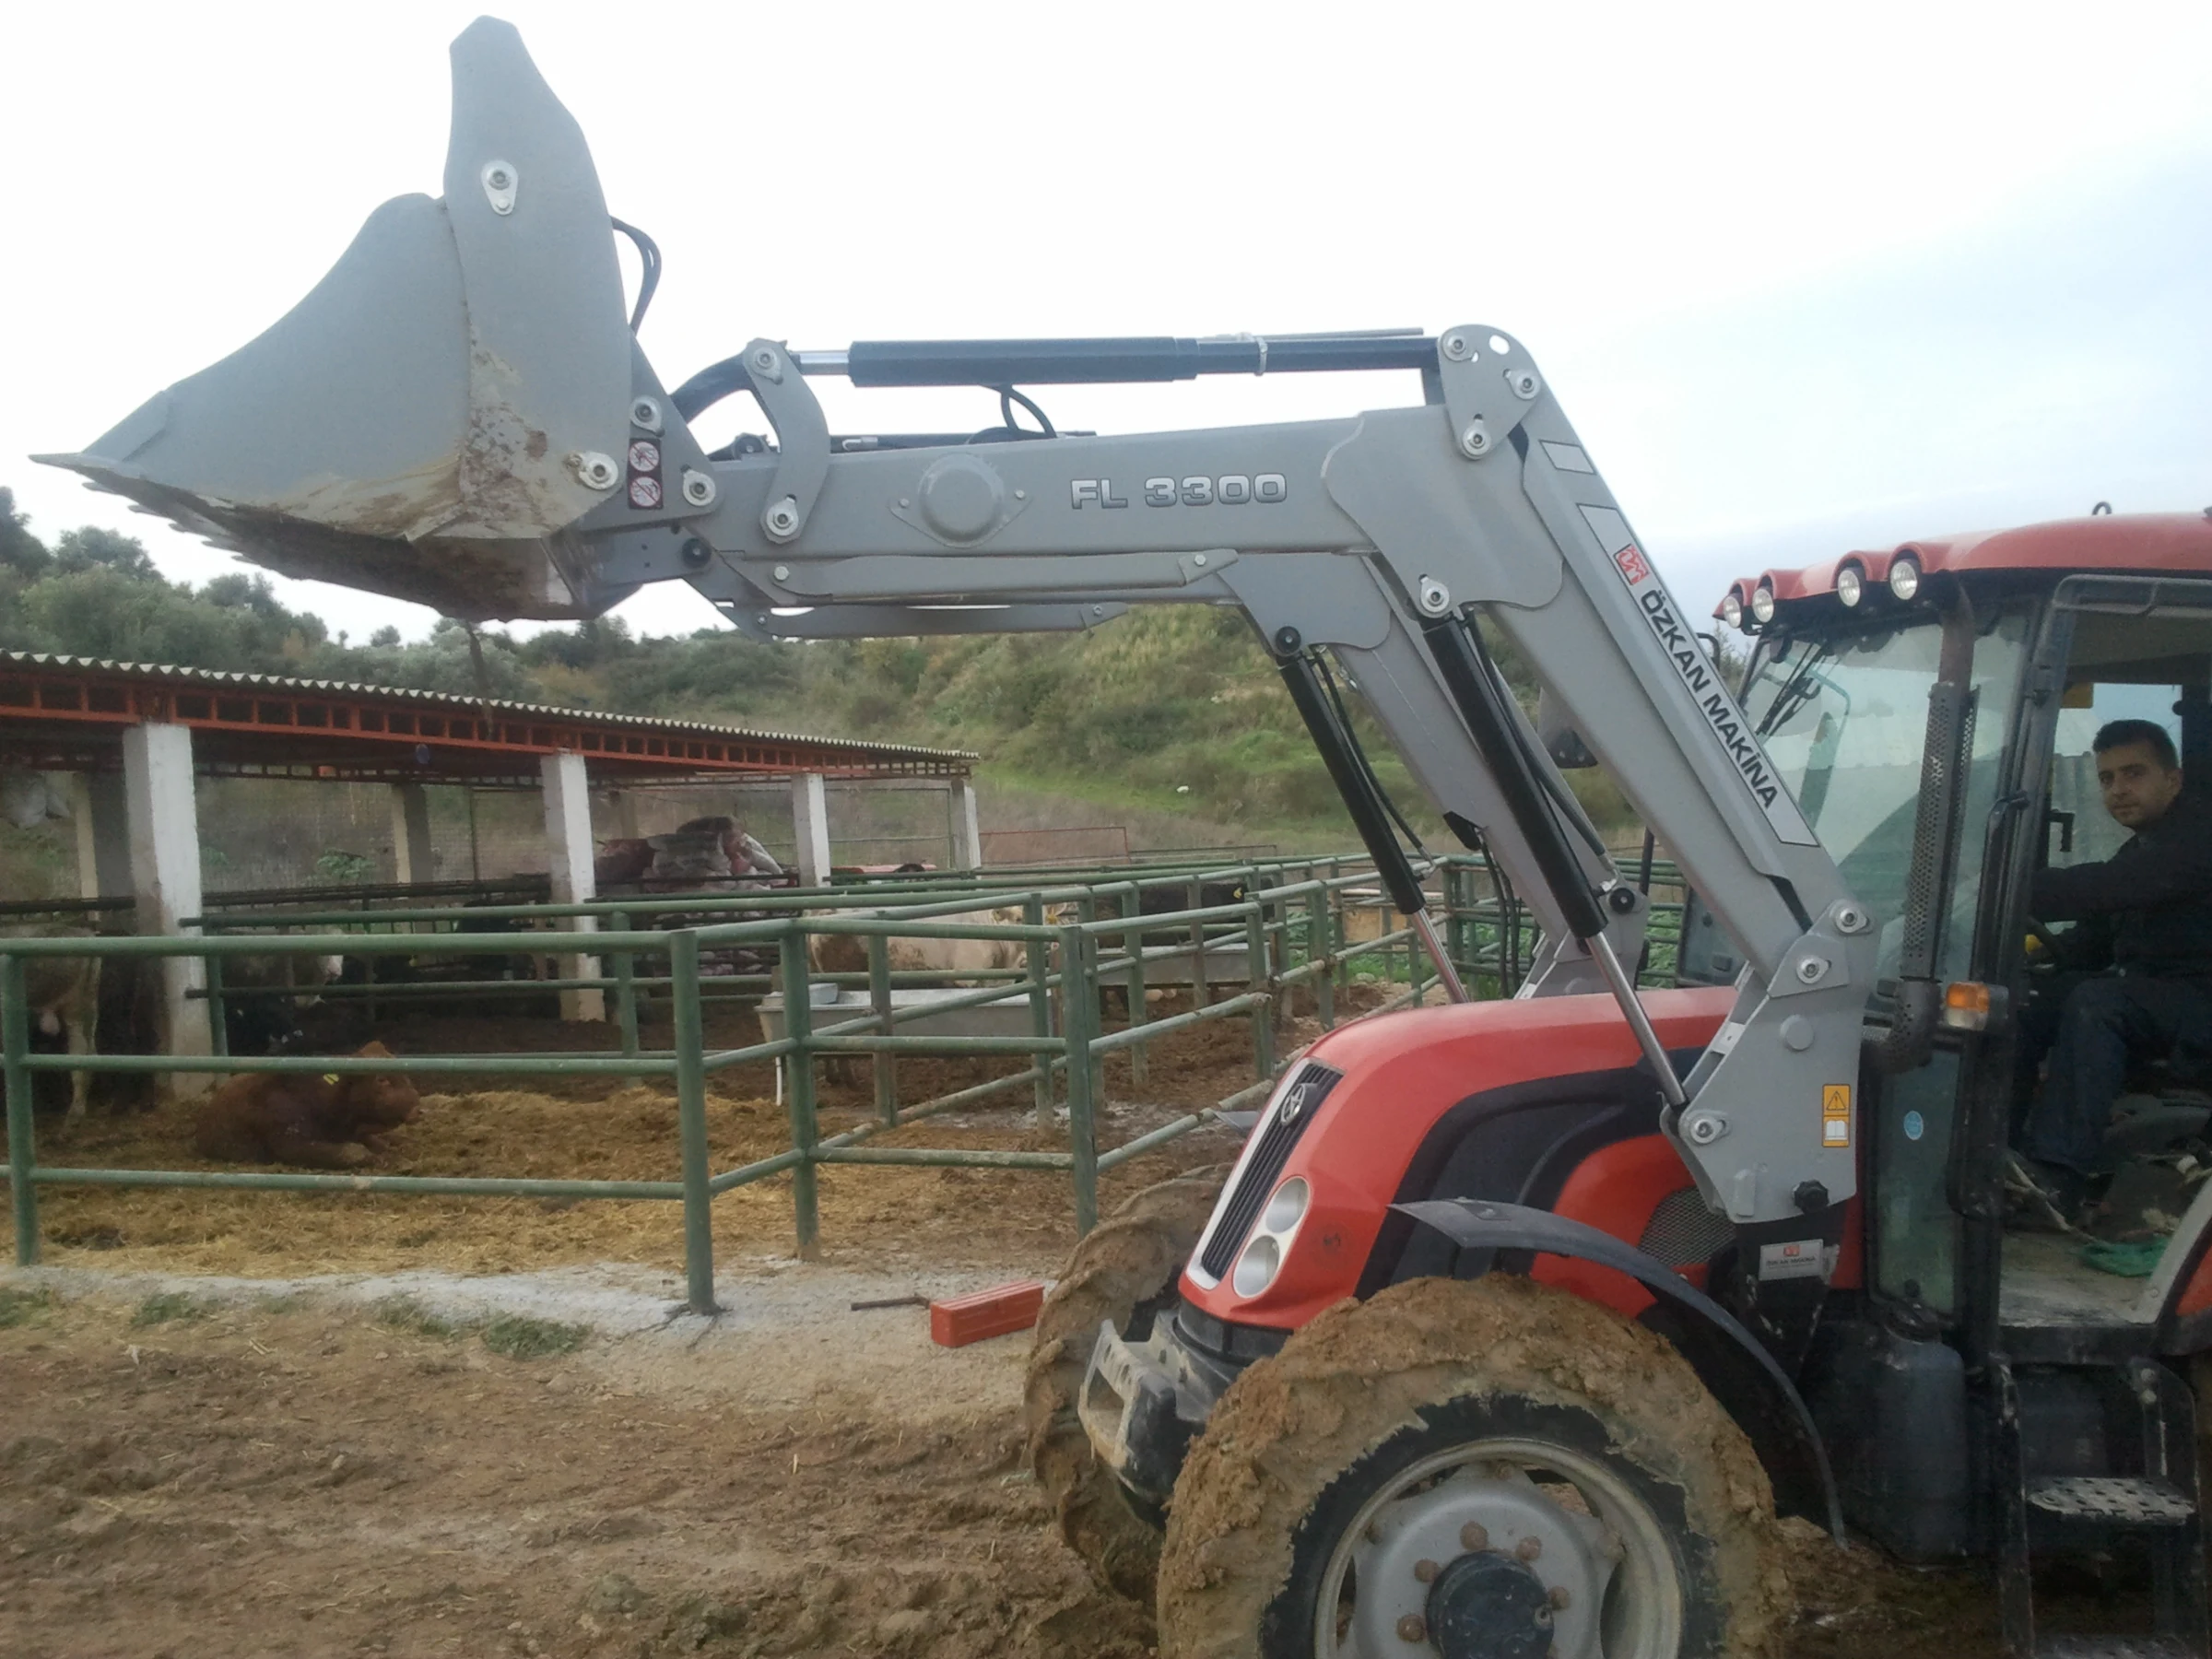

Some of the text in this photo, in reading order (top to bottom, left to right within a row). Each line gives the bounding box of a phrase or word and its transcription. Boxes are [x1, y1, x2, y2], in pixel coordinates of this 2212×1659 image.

[1070, 473, 1288, 510] FL 3300
[1641, 589, 1711, 694] ÖZKAN
